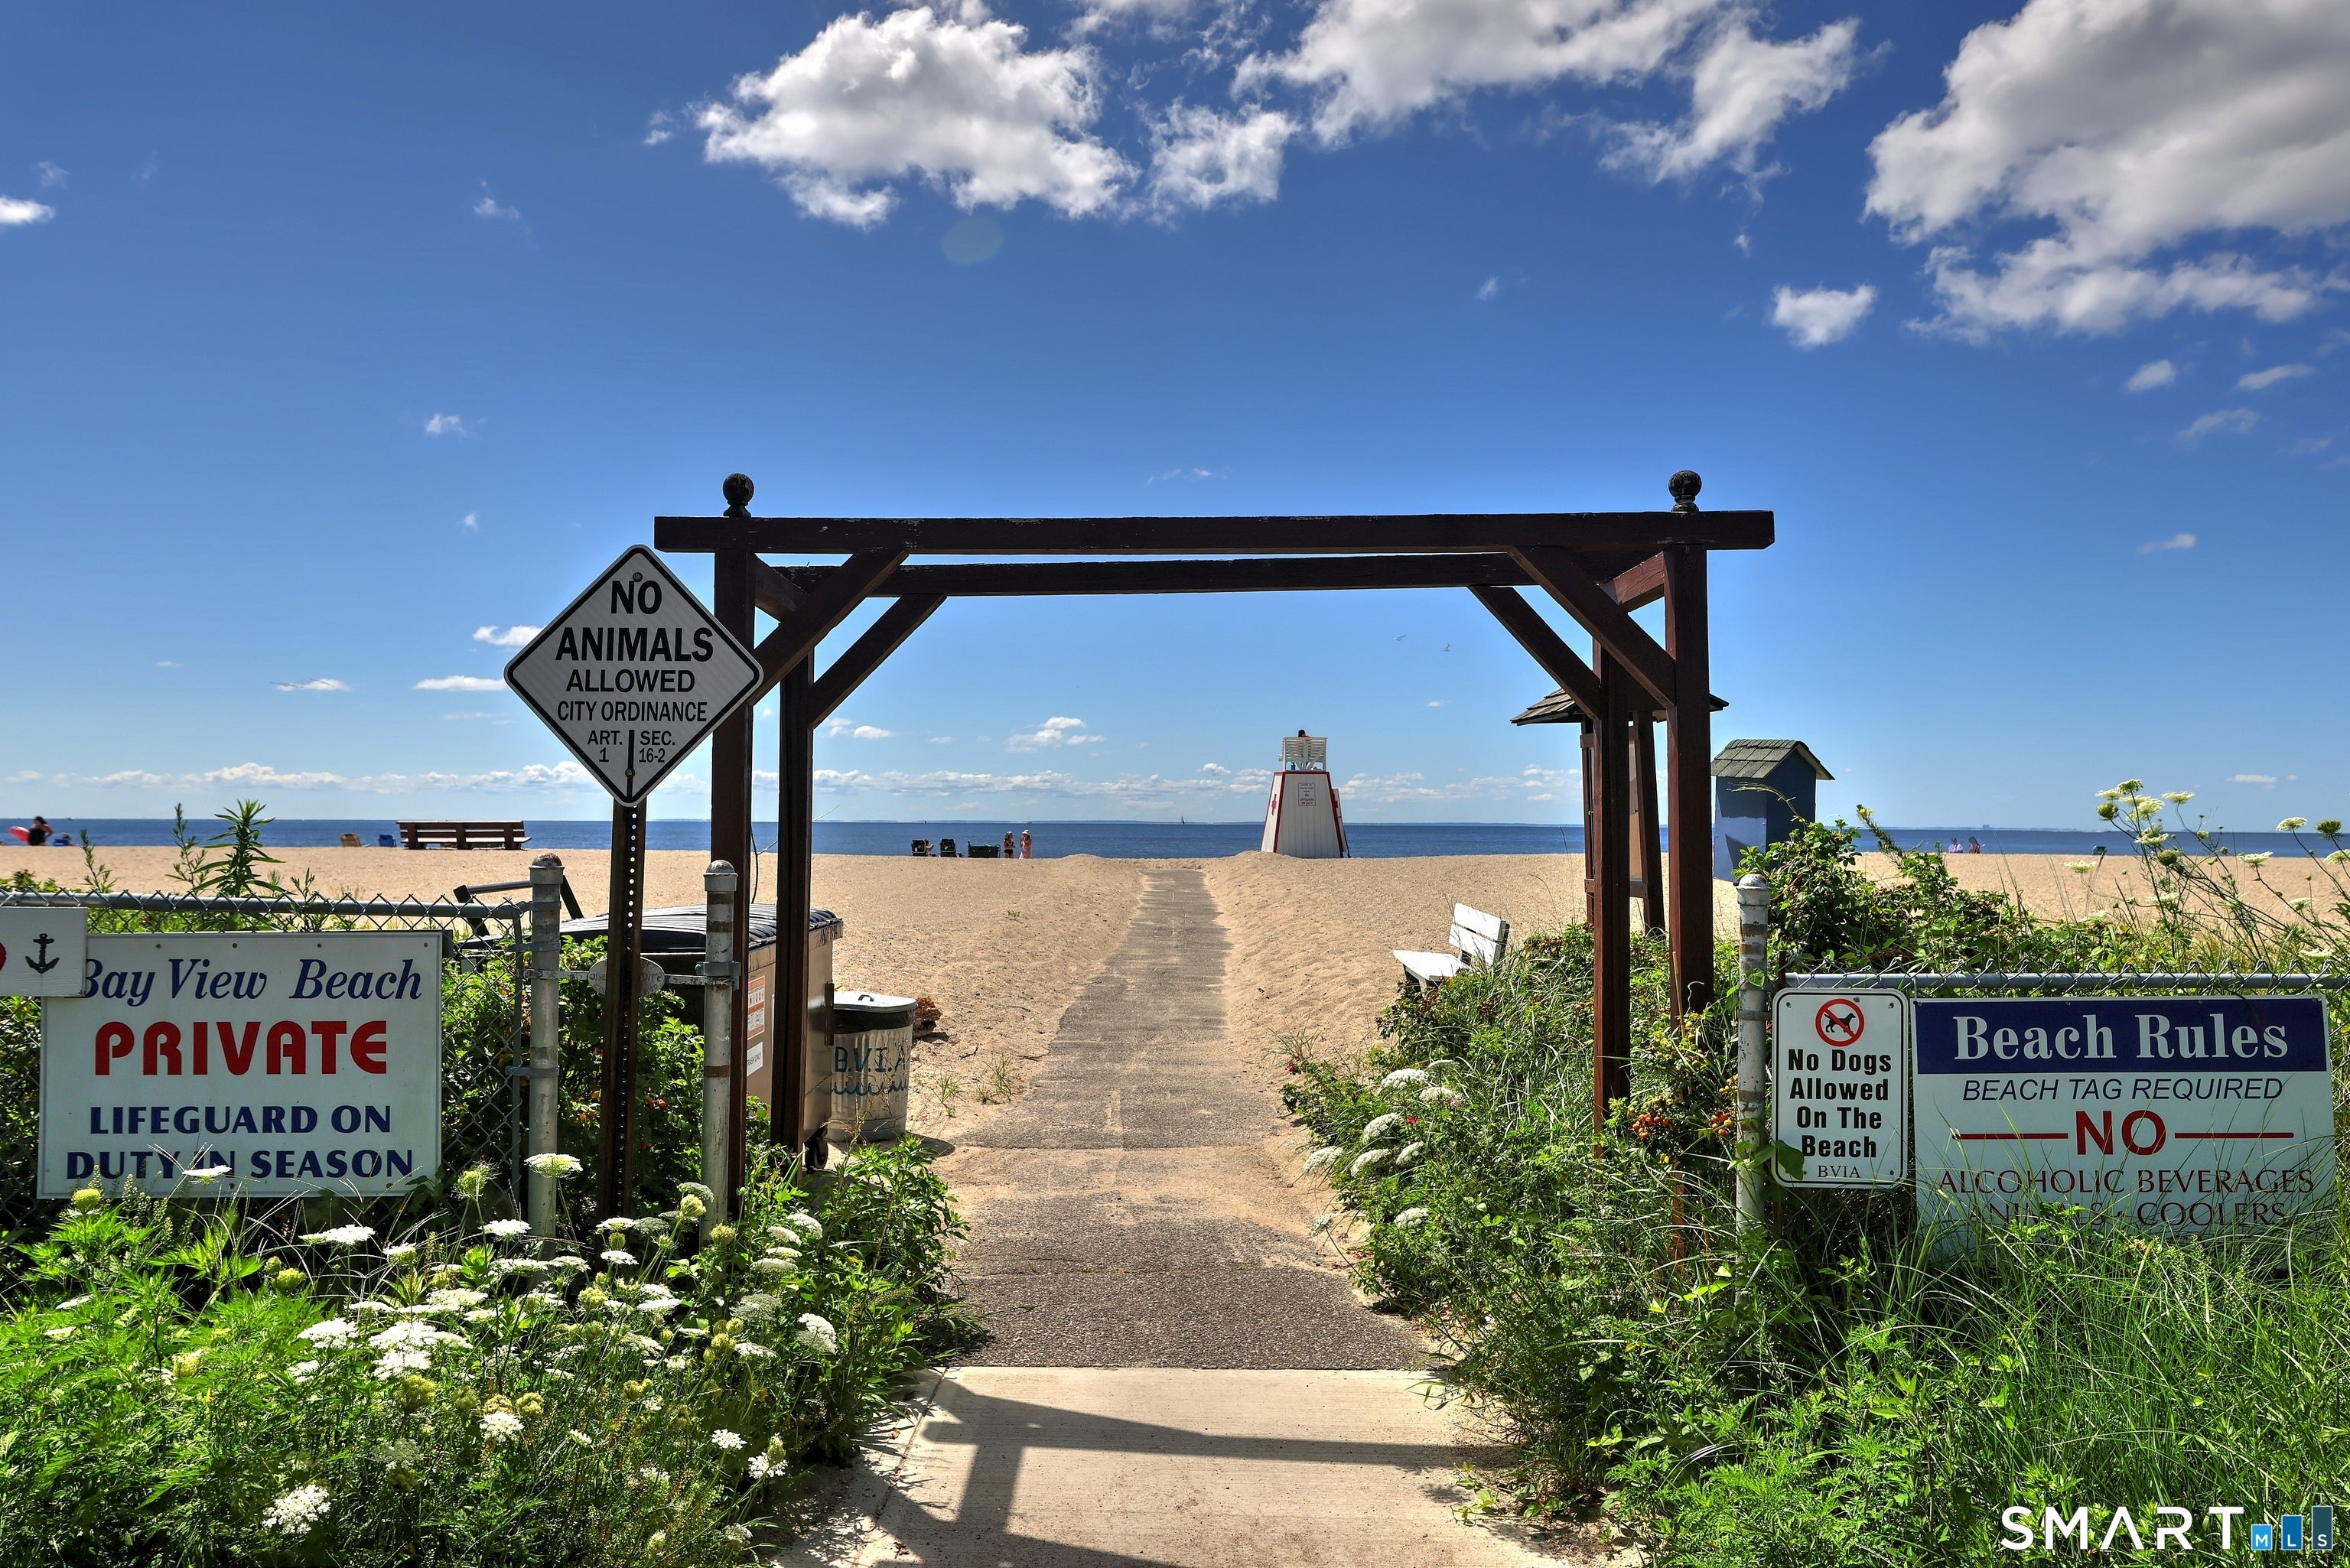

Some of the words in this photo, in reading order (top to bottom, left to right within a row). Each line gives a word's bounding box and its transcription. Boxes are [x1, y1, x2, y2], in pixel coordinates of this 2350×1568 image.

[611, 580, 662, 614] NO
[555, 627, 714, 662] ANIMALS
[566, 669, 695, 693] ALLOWED
[557, 701, 597, 721] CITY
[601, 701, 708, 722] ORDINANCE
[588, 730, 623, 746] ART.
[640, 730, 675, 746] SEC.
[598, 748, 610, 763] 1
[639, 748, 666, 763] 16-2
[86, 958, 156, 1007] Bay
[168, 958, 267, 1000] View
[289, 958, 422, 1000] Beach
[95, 1020, 386, 1075] PRIVATE
[1953, 1013, 2117, 1060] Beach
[2135, 1013, 2289, 1059] Rules
[1789, 1049, 1819, 1072] No
[1831, 1049, 1892, 1075] Dogs
[1789, 1078, 1889, 1101] Allowed
[1963, 1079, 2059, 1101] BEACH
[2068, 1078, 2123, 1101] TAG
[2131, 1078, 2283, 1101] REQUIRED
[90, 1105, 317, 1134] LIFEGUARD
[330, 1105, 391, 1134] ON
[1796, 1106, 1827, 1128] On
[1837, 1107, 1882, 1130] The
[2075, 1110, 2166, 1156] NO
[1802, 1135, 1876, 1158] Beach
[67, 1150, 181, 1179] DUTY
[193, 1150, 236, 1179] IN
[251, 1150, 412, 1179] SEASON
[1817, 1165, 1861, 1178] BVIA
[1939, 1169, 2125, 1194] ALCOHOLIC
[2137, 1169, 2314, 1193] BEVERAGES
[1969, 1202, 2104, 1226] ANILS
[2137, 1202, 2289, 1226] COOLERS
